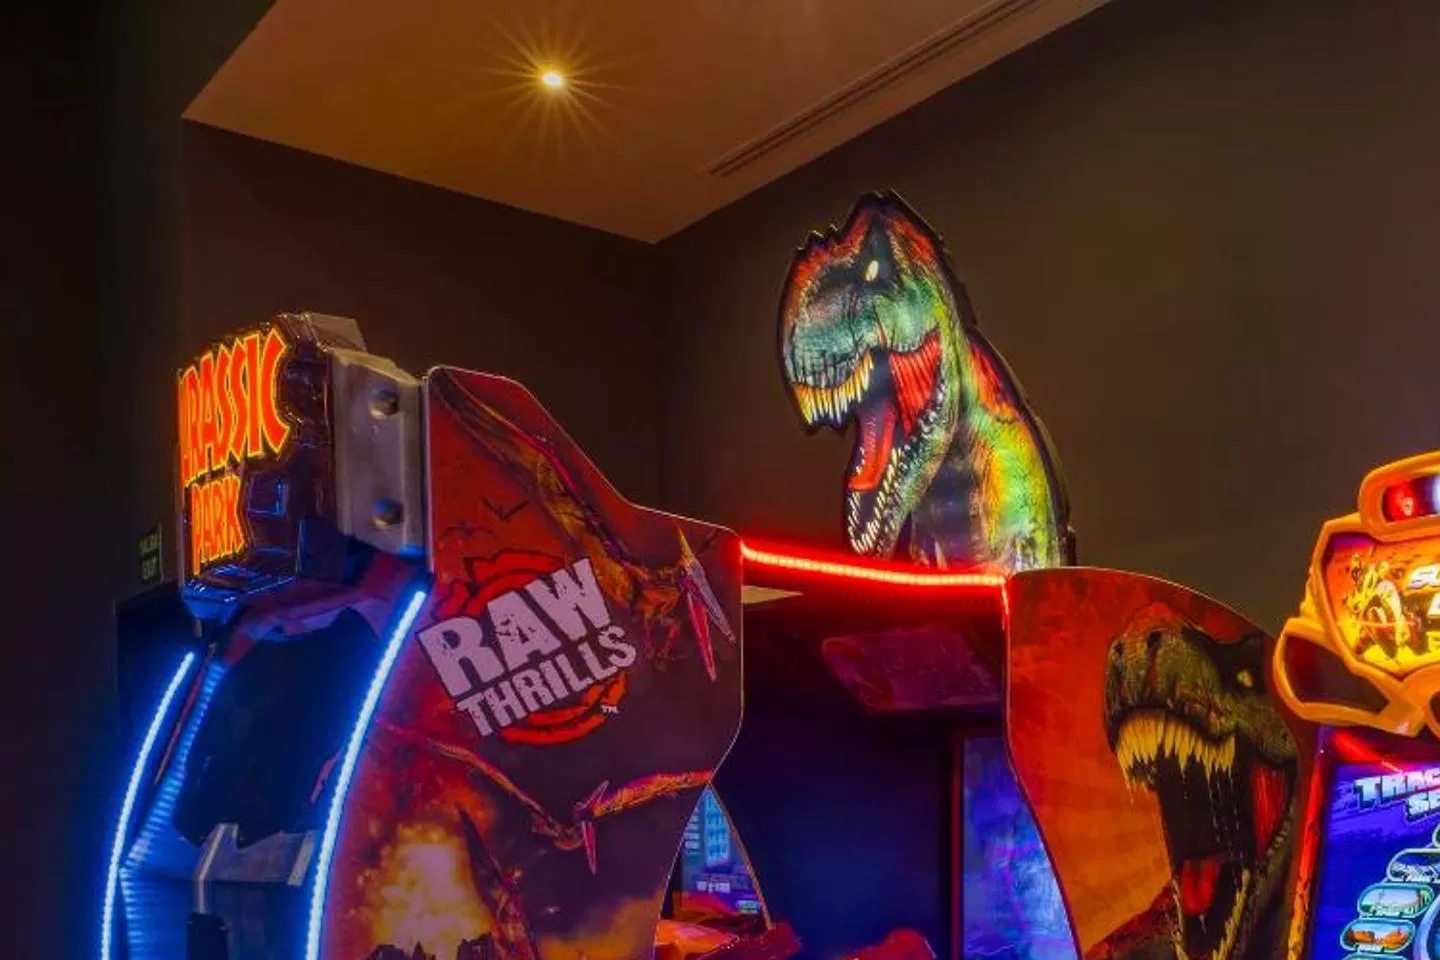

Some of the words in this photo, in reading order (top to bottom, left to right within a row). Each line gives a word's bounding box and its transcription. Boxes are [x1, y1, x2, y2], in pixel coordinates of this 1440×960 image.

[179, 328, 290, 487] RASSIC
[191, 474, 245, 576] PARK
[416, 558, 611, 697] RAW
[456, 625, 638, 737] THRILLS
